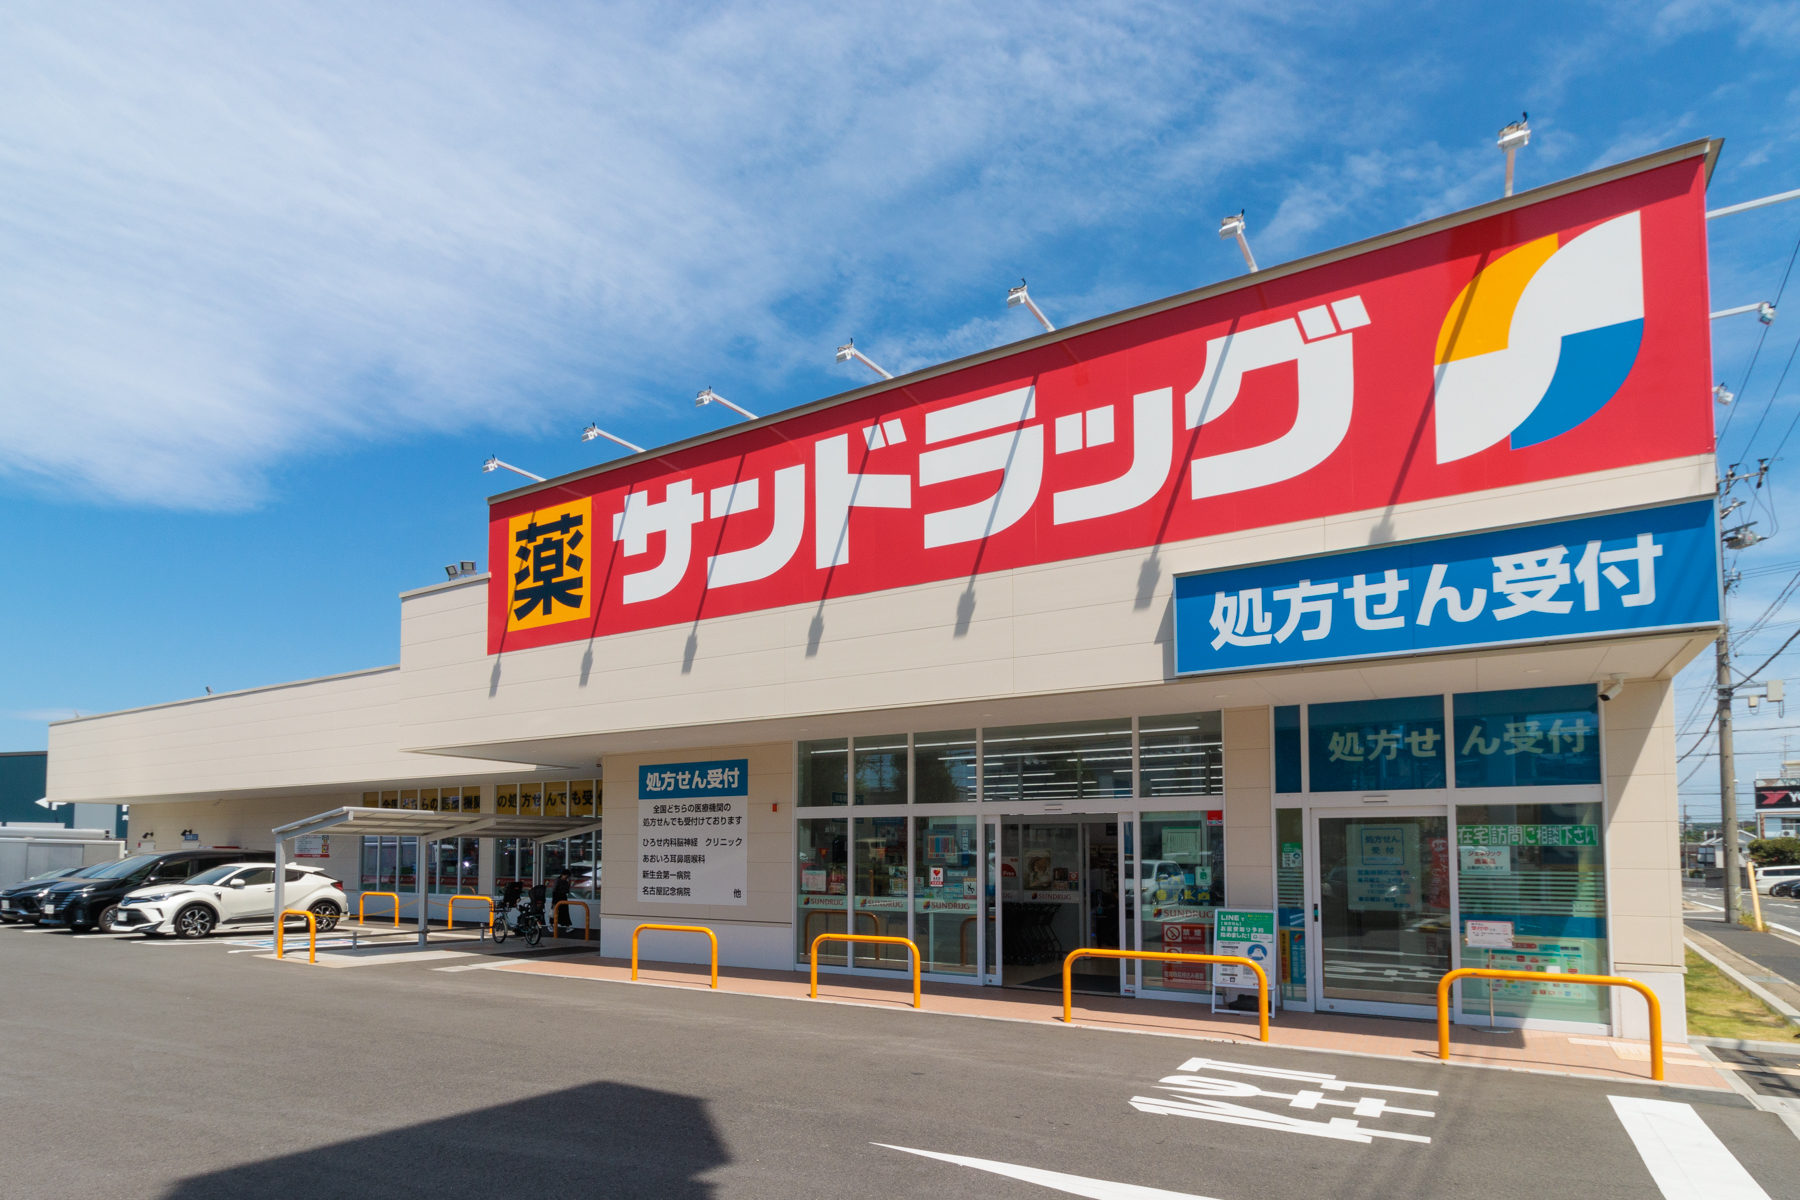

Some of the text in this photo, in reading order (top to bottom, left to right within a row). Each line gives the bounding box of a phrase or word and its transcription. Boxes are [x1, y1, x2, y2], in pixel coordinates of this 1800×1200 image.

[613, 295, 1371, 605] サンドラッグ
[514, 513, 583, 621] 薬
[1209, 533, 1662, 650] 処方せん受付
[1328, 719, 1590, 762] 処方せん受付
[646, 767, 739, 791] 処方せん受付
[653, 803, 731, 814] 全国どちらの医療機関の
[642, 815, 742, 827] 処方せんでも受付けております
[1365, 835, 1400, 844] 処方せん
[1458, 826, 1596, 844] 在宅訪問ご相談下さい
[642, 837, 742, 847] ひろせ内科脳神経 クリニック
[642, 854, 705, 864] あおいろ耳鼻咽喉科
[642, 870, 691, 880] 新生会第一病院
[642, 886, 742, 898] 名古屋記念病院 他
[811, 898, 843, 906] SUNDRUG
[868, 900, 903, 908] SUNDRUG
[932, 902, 970, 910] SUNDRUG
[1164, 909, 1213, 918] SUNDRUG
[1128, 1057, 1439, 1143] 止まれ
